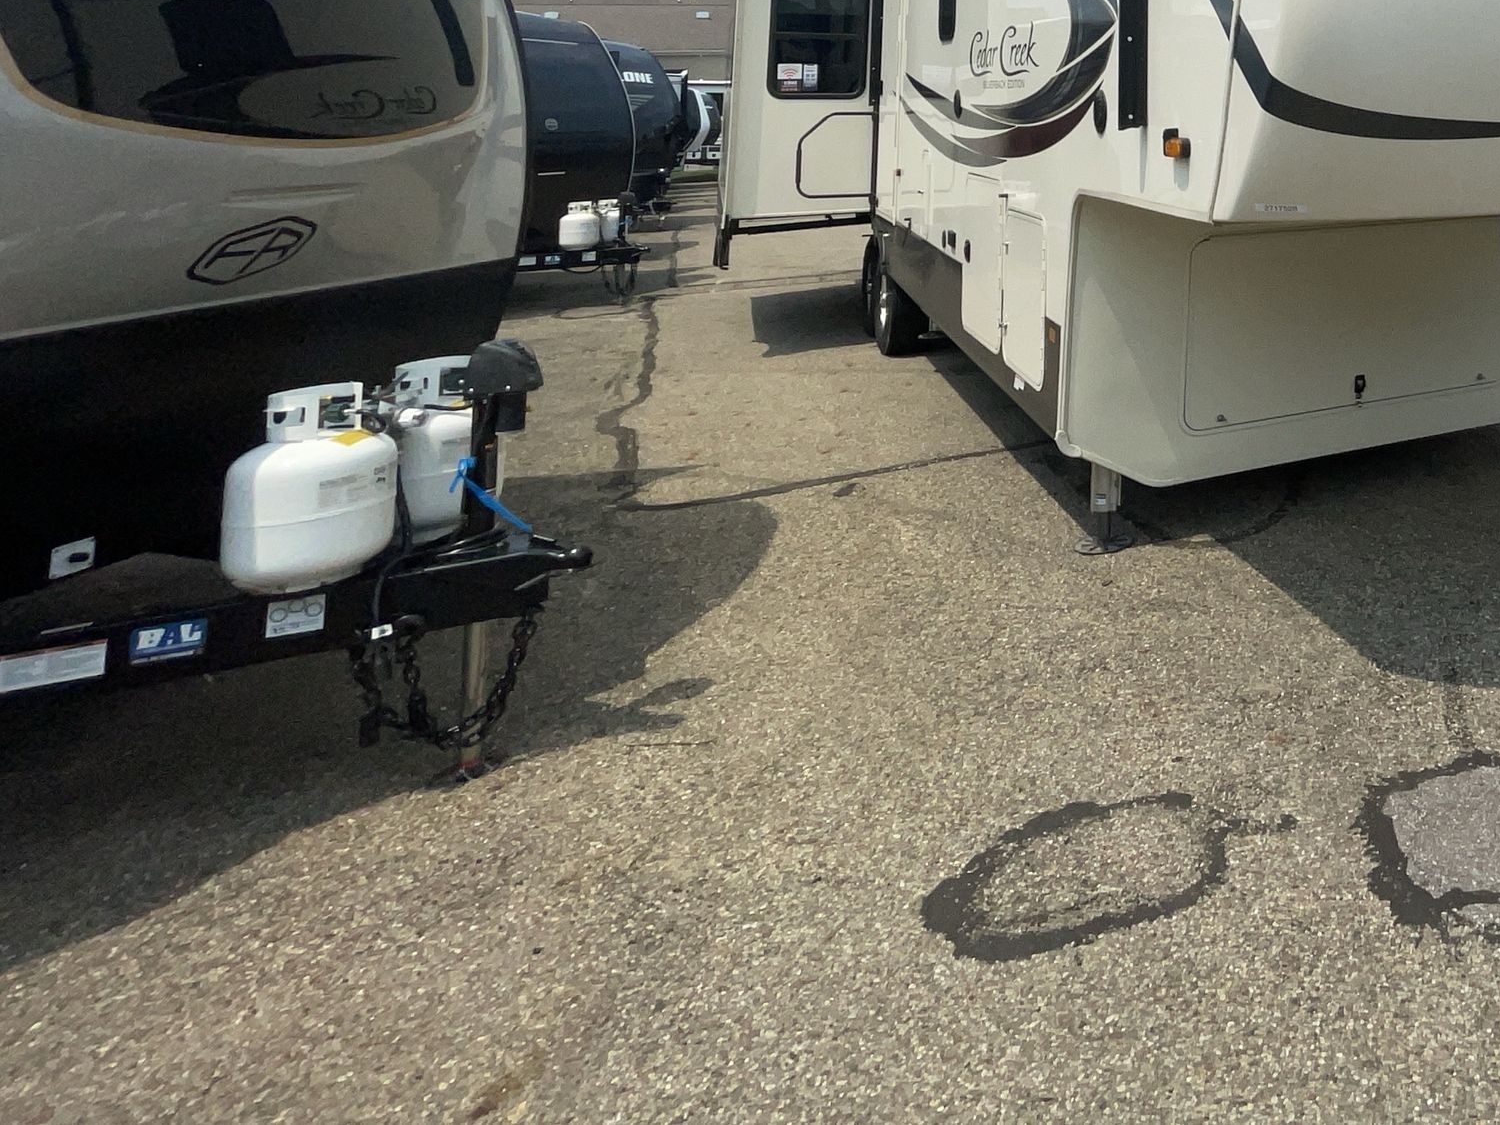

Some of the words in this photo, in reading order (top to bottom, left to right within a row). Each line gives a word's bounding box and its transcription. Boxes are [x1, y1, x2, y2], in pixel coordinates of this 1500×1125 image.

[969, 29, 998, 77] Cedar
[1000, 21, 1040, 77] Creek
[621, 71, 654, 84] ONE
